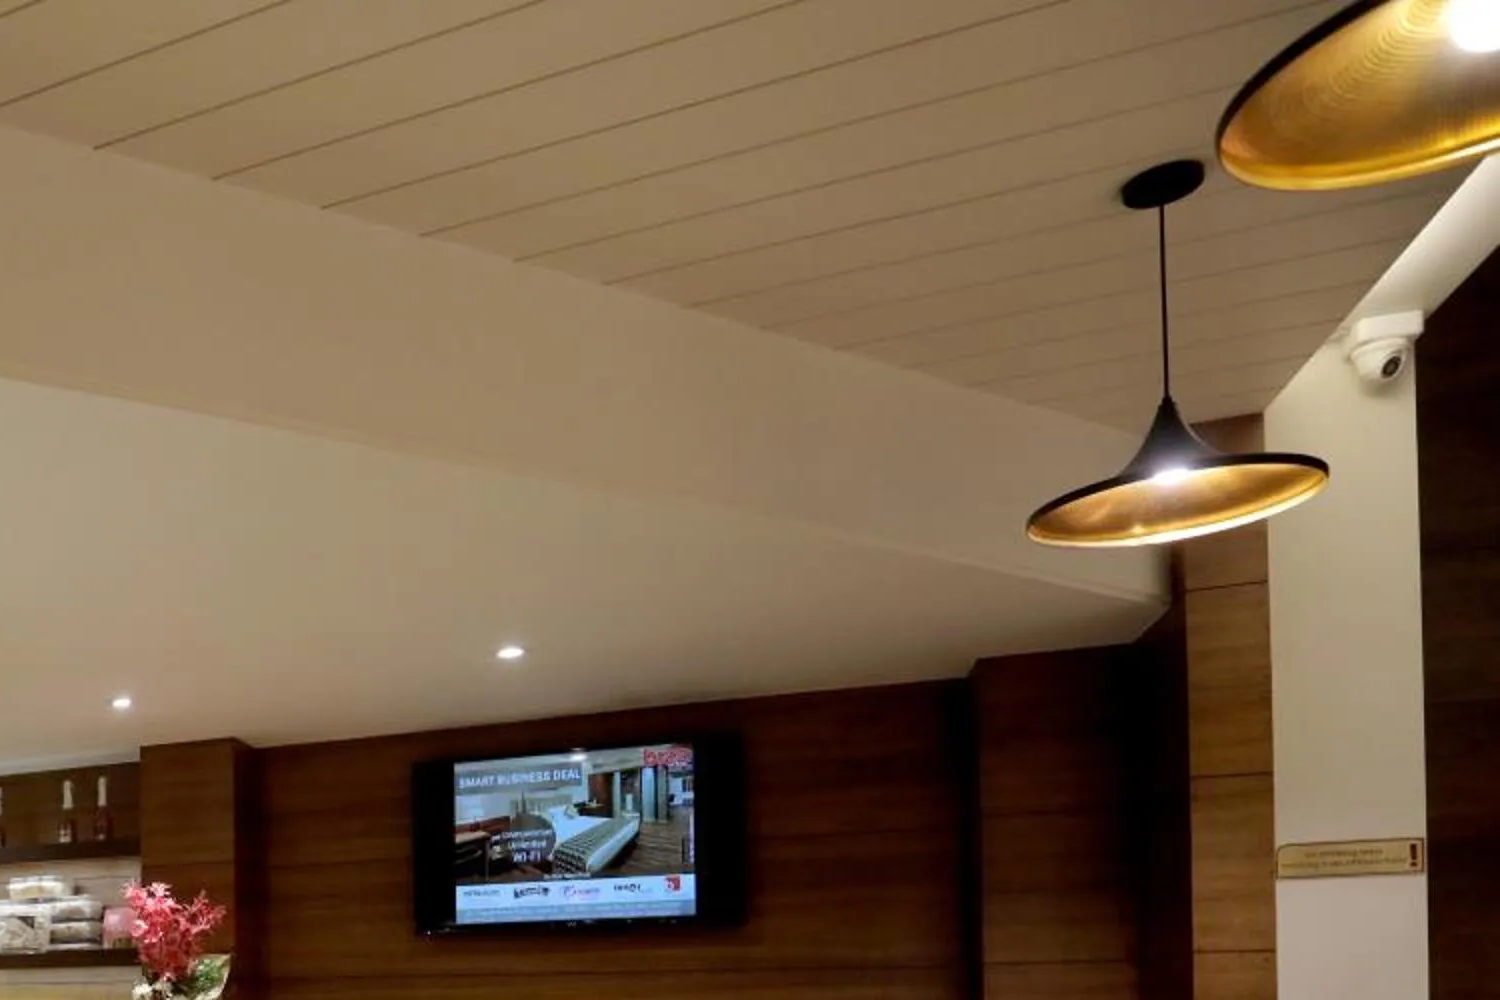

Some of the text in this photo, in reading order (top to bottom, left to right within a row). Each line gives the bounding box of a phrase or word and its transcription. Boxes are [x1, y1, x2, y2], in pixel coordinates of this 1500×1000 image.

[458, 768, 581, 789] SMART BUSINESS DEAL
